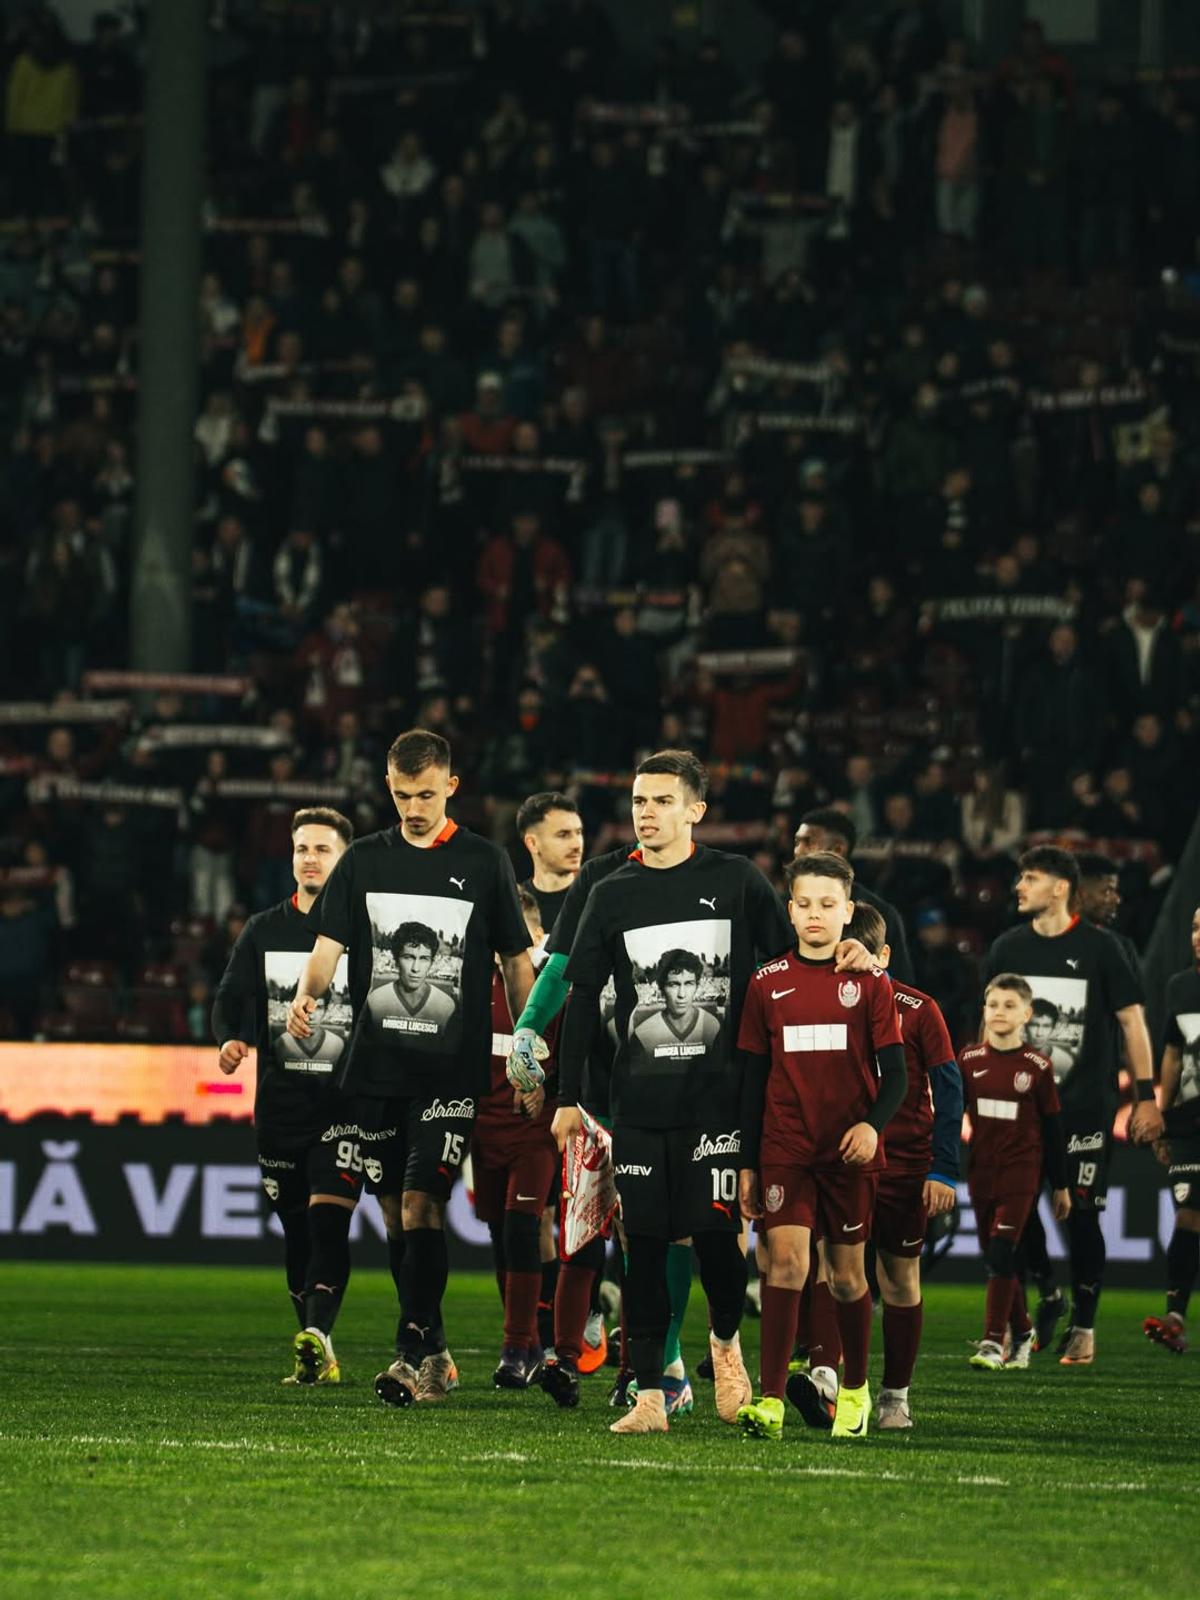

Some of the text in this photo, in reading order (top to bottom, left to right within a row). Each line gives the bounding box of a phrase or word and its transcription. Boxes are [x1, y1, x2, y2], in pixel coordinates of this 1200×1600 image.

[441, 1131, 465, 1166] 15
[711, 1167, 737, 1201] 10
[1078, 1161, 1097, 1186] 19
